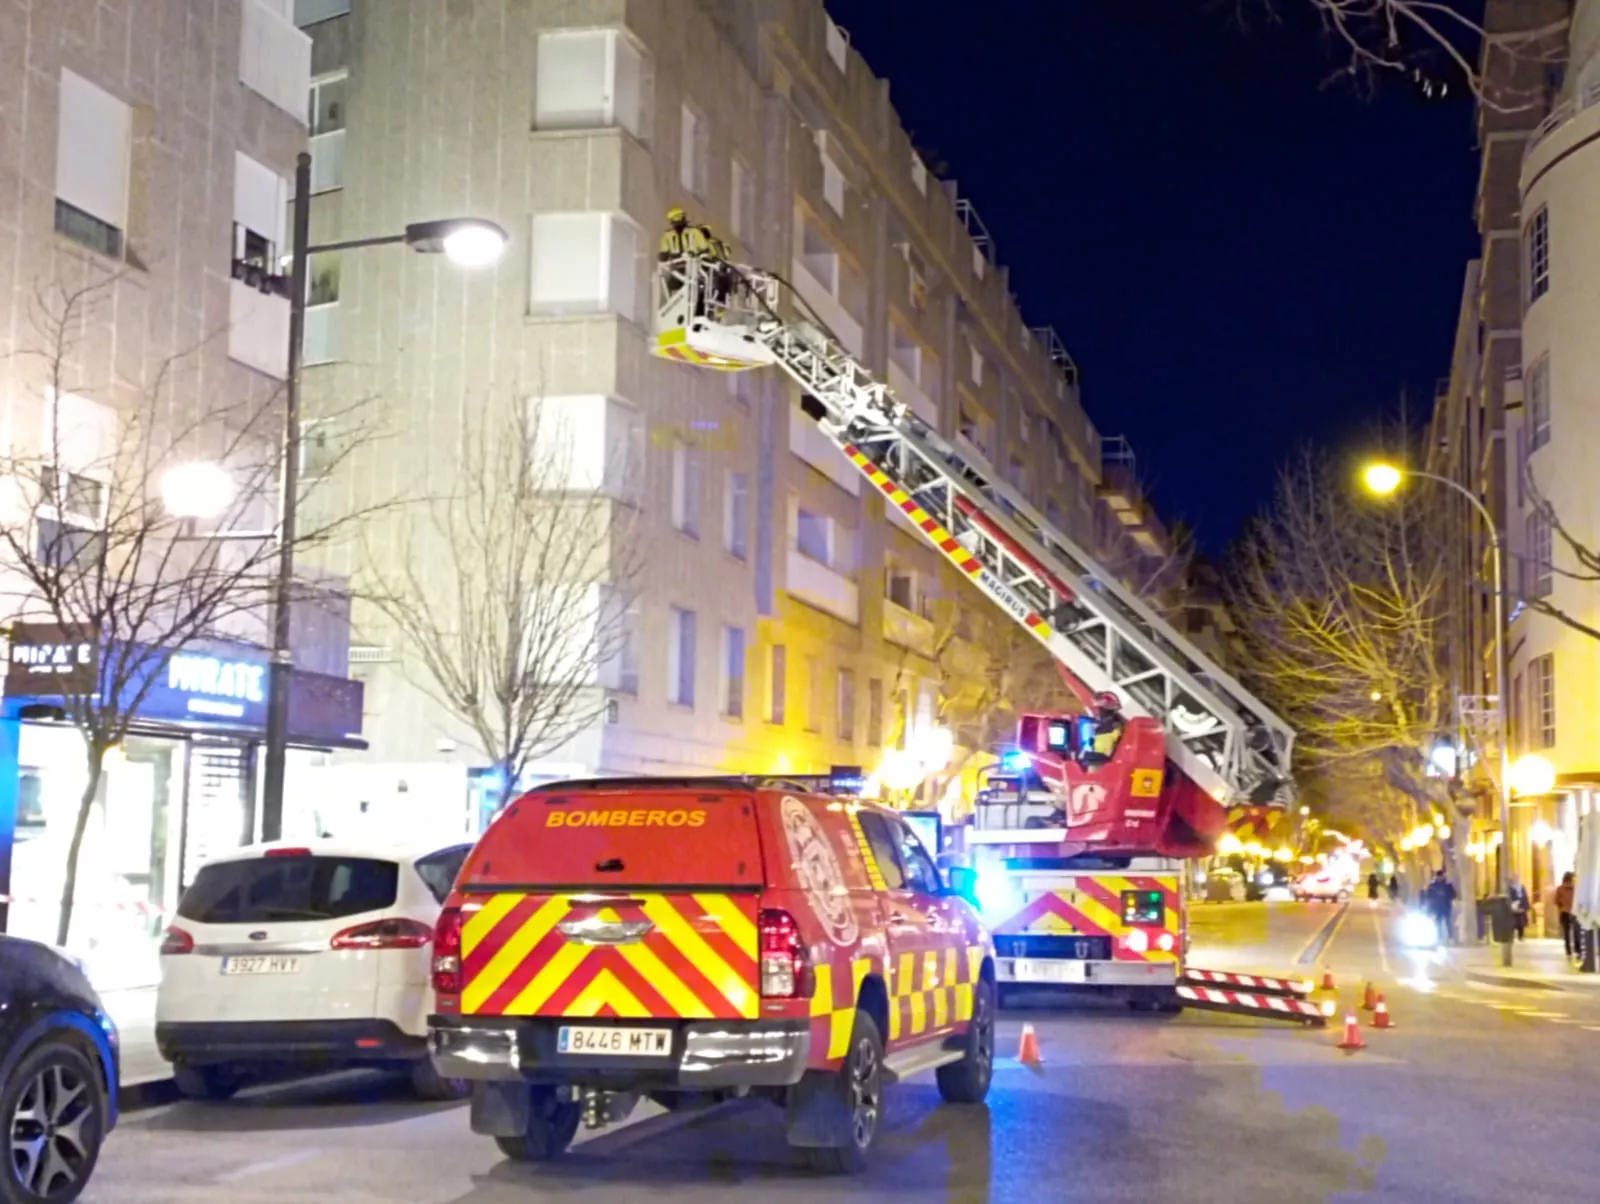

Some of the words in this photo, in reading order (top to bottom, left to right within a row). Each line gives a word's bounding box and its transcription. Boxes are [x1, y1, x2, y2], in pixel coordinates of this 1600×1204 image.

[545, 809, 708, 828] BOMBEROS
[573, 1030, 622, 1050] 8446
[628, 1032, 667, 1051] MTW
